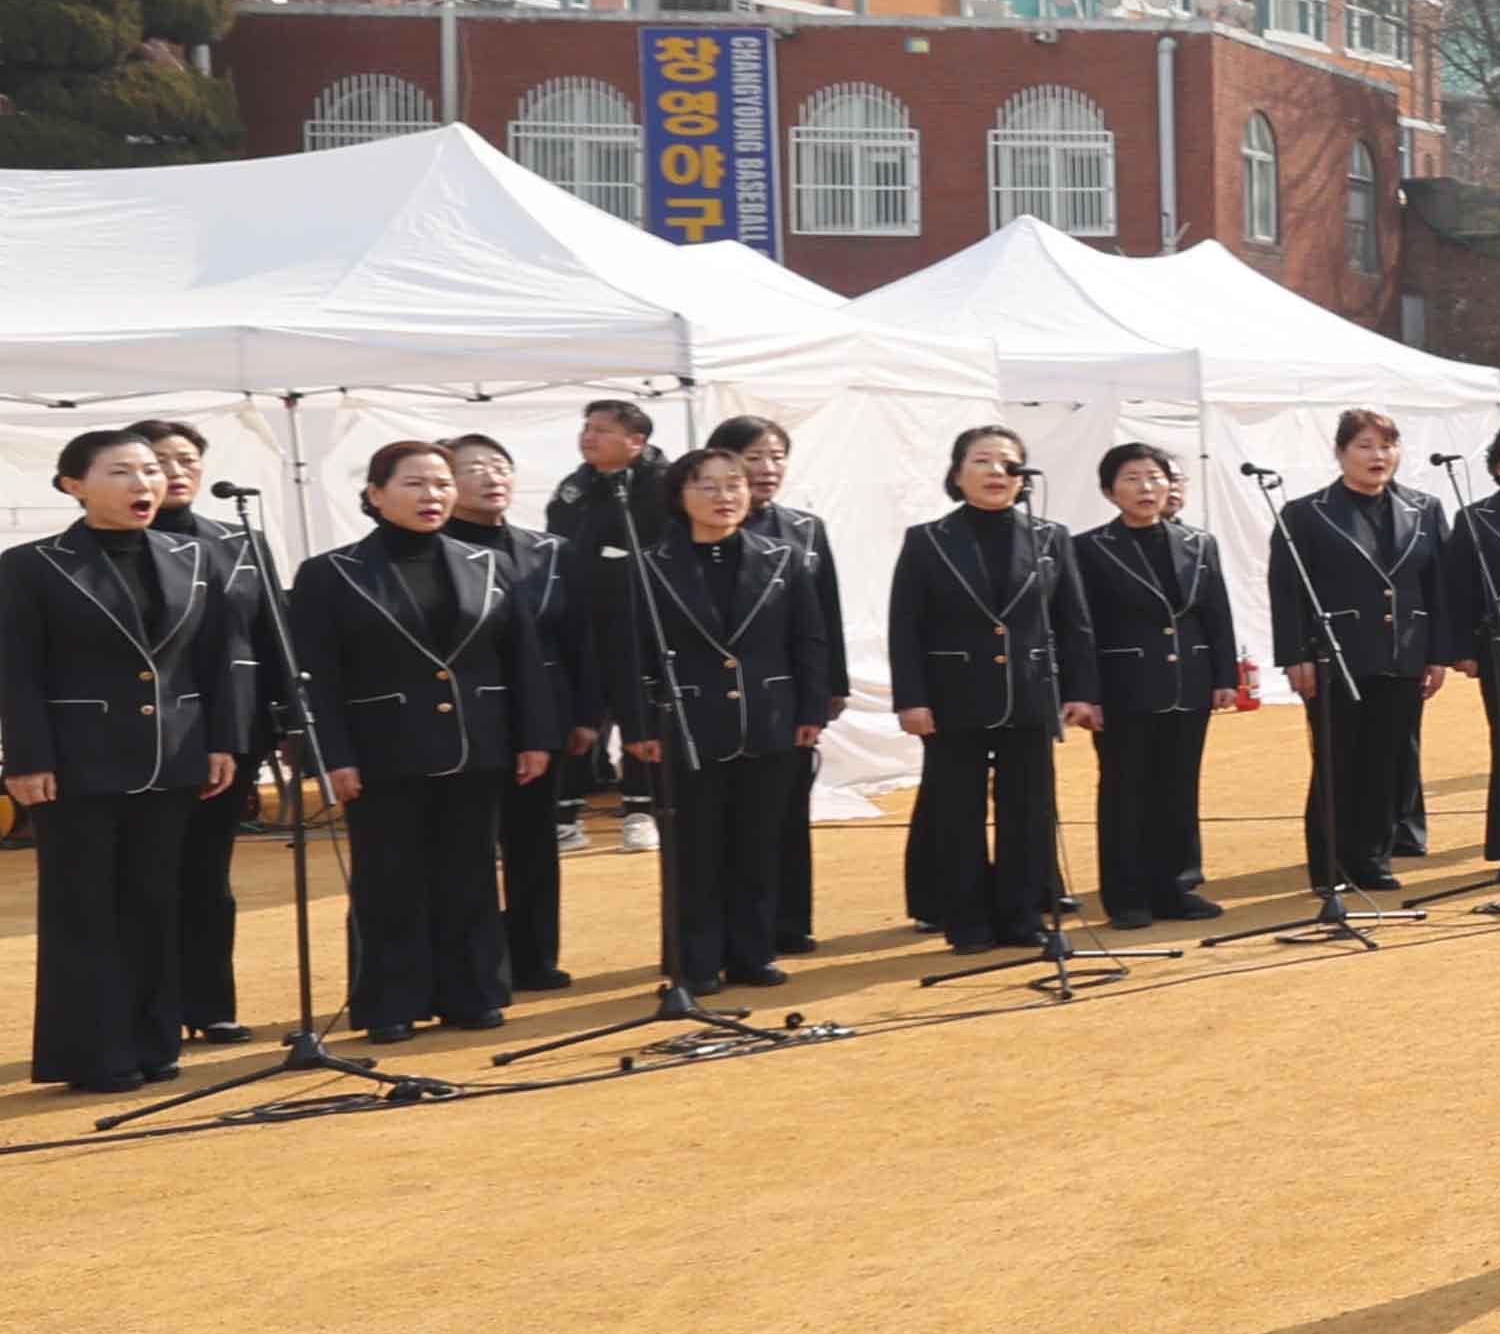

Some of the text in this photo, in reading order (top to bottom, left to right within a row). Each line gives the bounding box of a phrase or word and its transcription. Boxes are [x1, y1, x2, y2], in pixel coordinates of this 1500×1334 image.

[654, 36, 727, 242] 창영야구
[730, 36, 766, 153] CHANGYOUNG
[735, 157, 769, 244] BASEBALL
